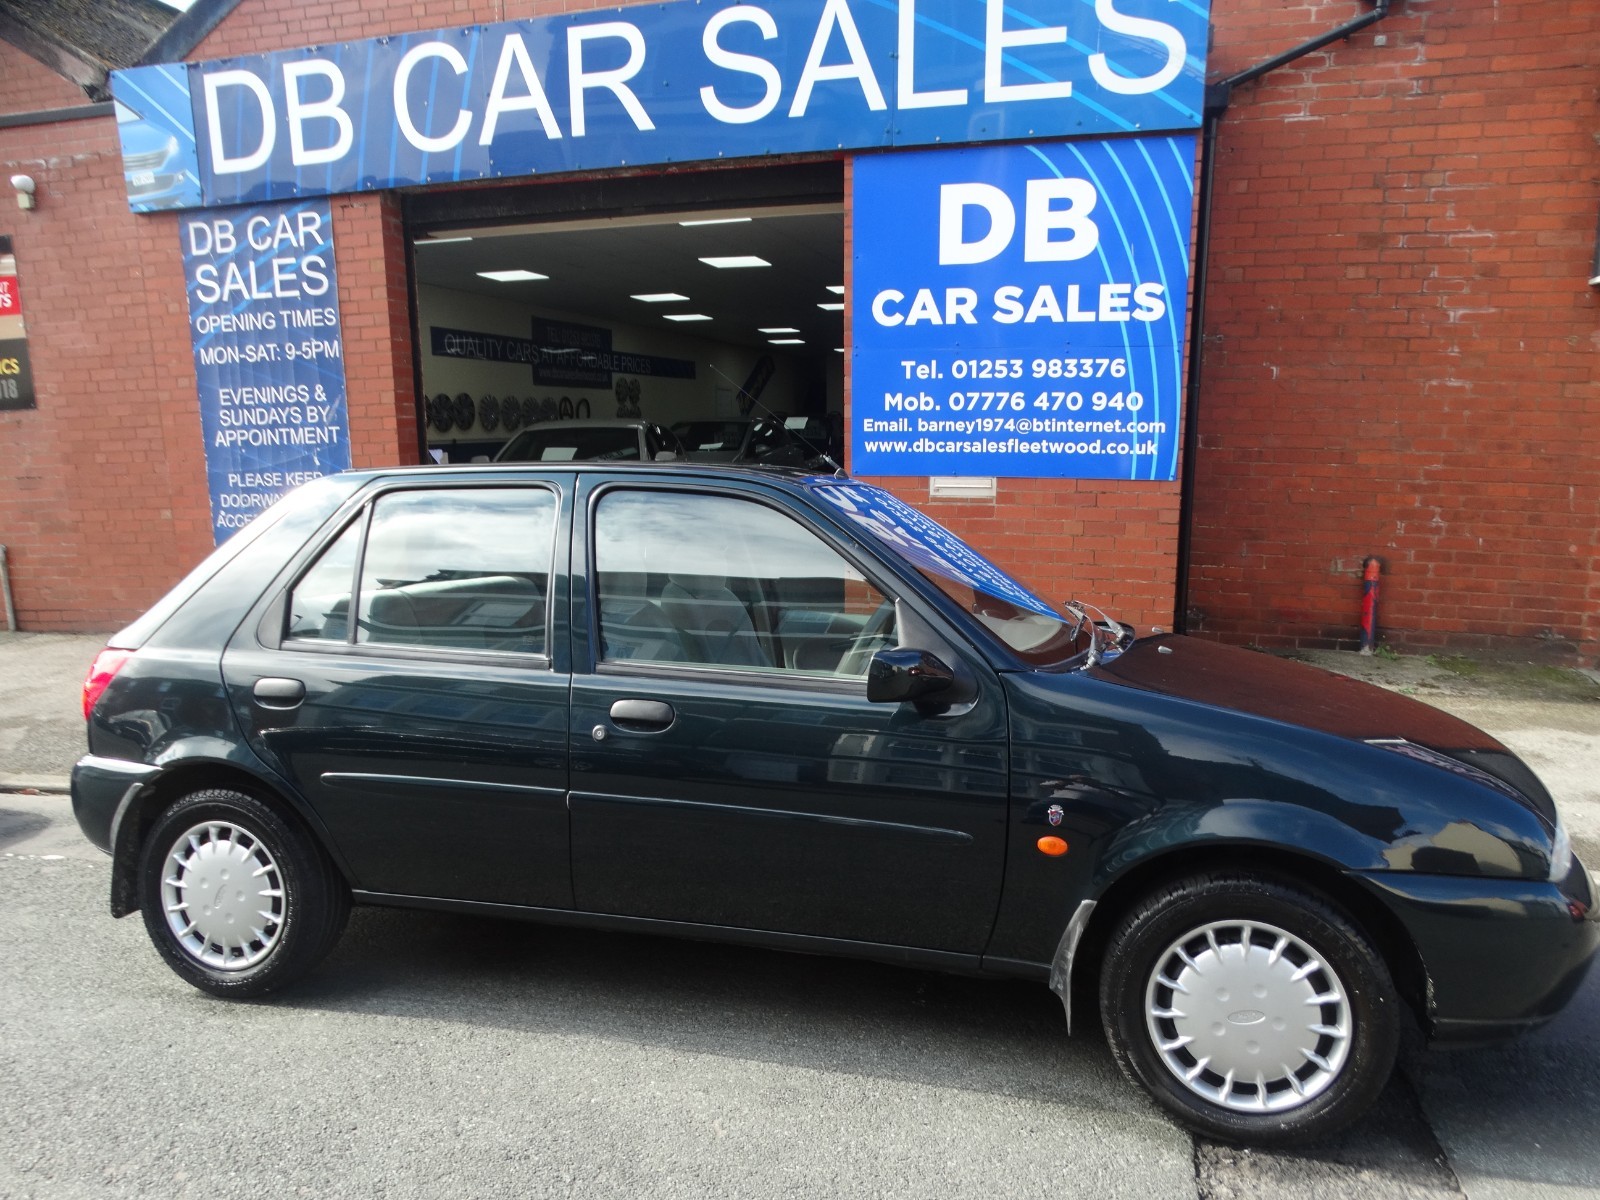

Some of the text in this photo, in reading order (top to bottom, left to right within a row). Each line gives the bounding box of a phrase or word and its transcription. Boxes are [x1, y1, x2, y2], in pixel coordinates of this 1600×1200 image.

[202, 0, 1187, 175] DB CAR SALES
[188, 210, 325, 255] DB CAR
[940, 177, 1099, 265] DB
[194, 254, 329, 304] SALES
[871, 282, 1166, 327] CAR SALES
[195, 307, 337, 335] OPENING TIMES
[199, 337, 340, 366] MON-SAT: 9-5PM
[443, 333, 652, 374] QUALITY CARS AT AFFORDABLE PRICES
[900, 358, 1126, 380] Tel. 01253 983376
[218, 383, 327, 407] EVENINGS &
[884, 391, 1144, 412] Mob. 07776 470 940
[218, 404, 331, 427] SUNDAYS BY
[863, 417, 1166, 435] Email. barney1974@btinternet.com
[214, 425, 341, 448] APPOINTMENT
[864, 437, 1158, 456] www.dbcarsalesfleetwood.co.uk
[228, 472, 283, 487] PLEASE
